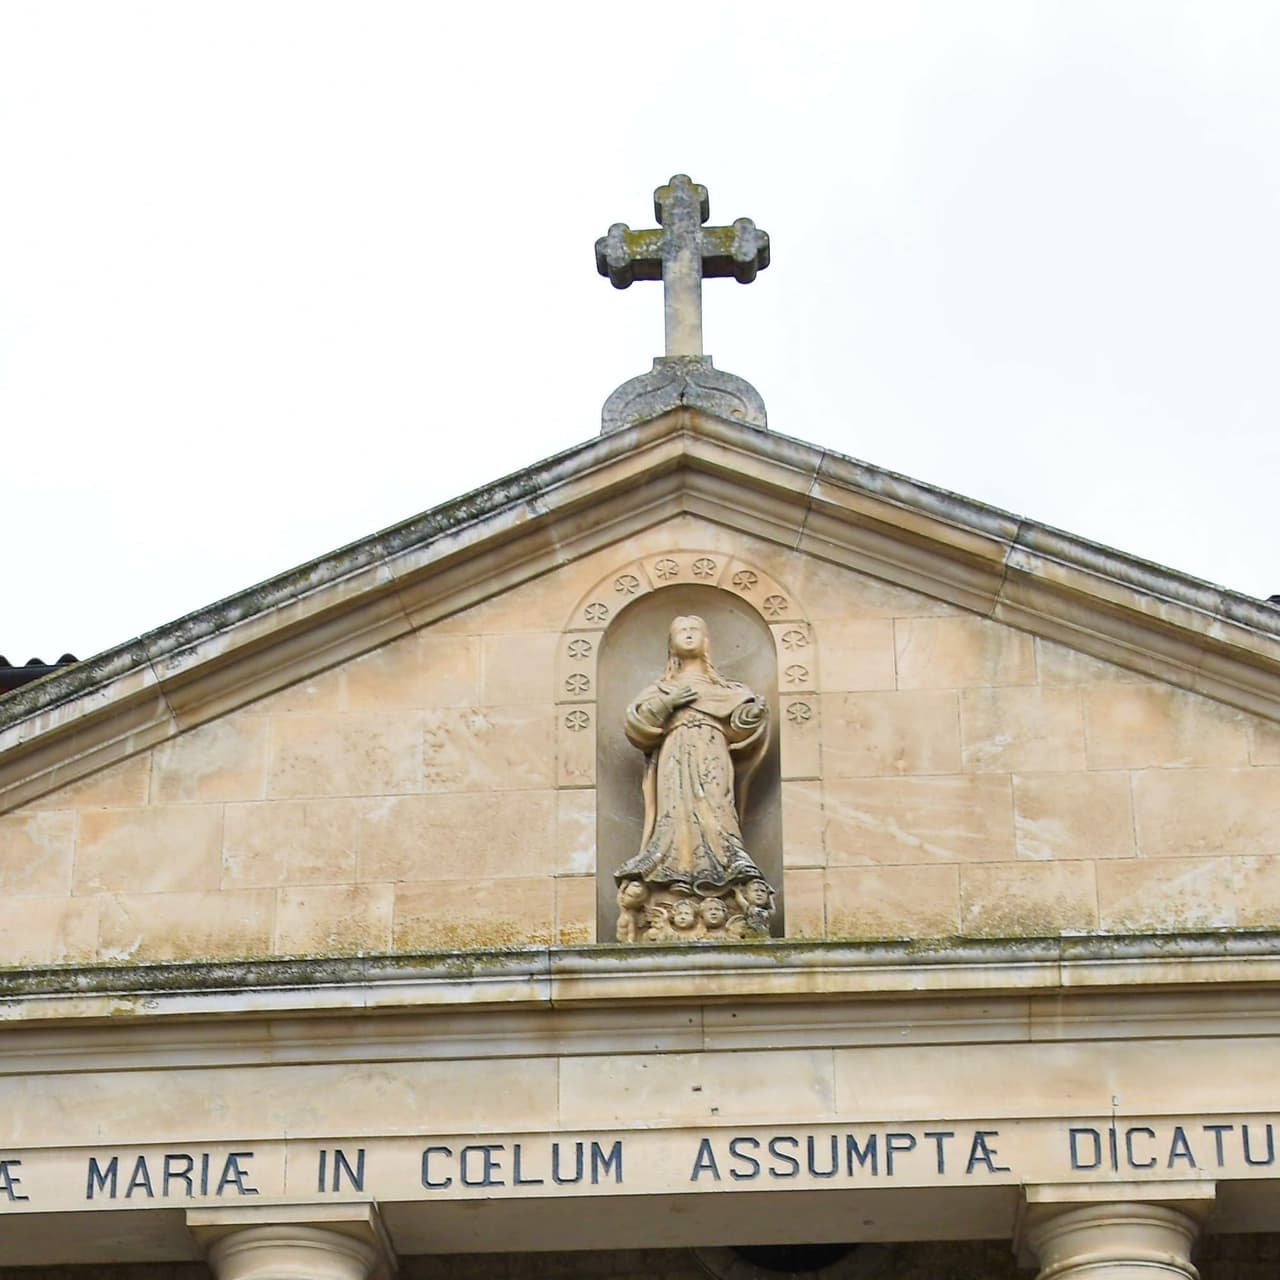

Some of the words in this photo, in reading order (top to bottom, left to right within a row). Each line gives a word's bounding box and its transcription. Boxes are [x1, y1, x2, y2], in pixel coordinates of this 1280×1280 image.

[86, 1151, 258, 1199] MARIÆ
[318, 1148, 367, 1193] IN
[690, 1130, 1011, 1182] ASSUMPTÆ
